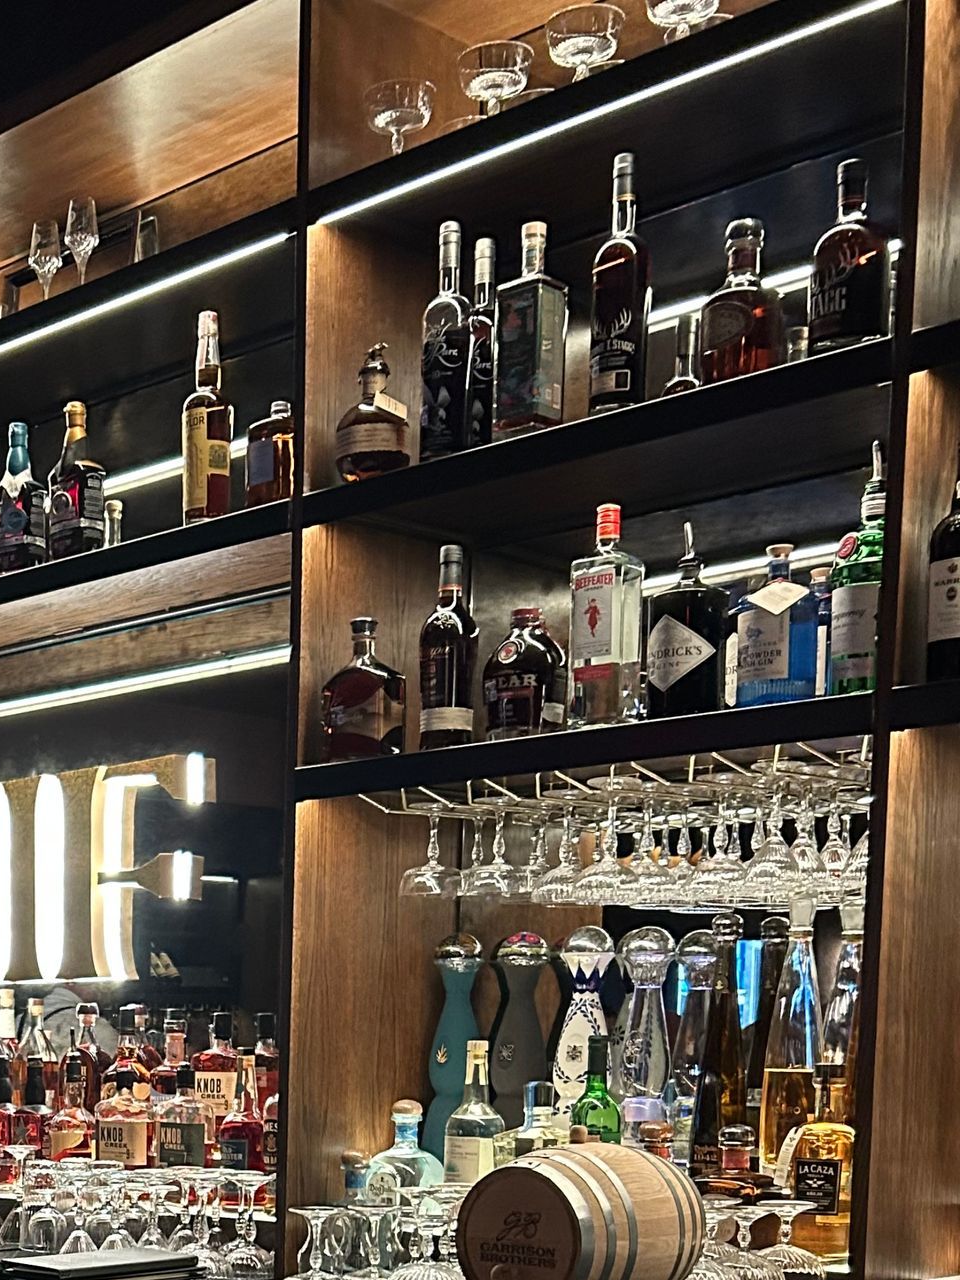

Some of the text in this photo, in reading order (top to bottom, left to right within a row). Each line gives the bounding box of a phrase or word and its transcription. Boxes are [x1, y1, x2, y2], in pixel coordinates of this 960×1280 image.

[575, 573, 614, 591] BEEFEATER
[196, 1078, 221, 1093] KNOB
[101, 1127, 123, 1142] KNOB
[161, 1128, 182, 1143] KNOB
[799, 1164, 834, 1175] LA CAZA
[480, 1242, 556, 1257] GARRISON
[480, 1252, 556, 1269] BROTHERS
